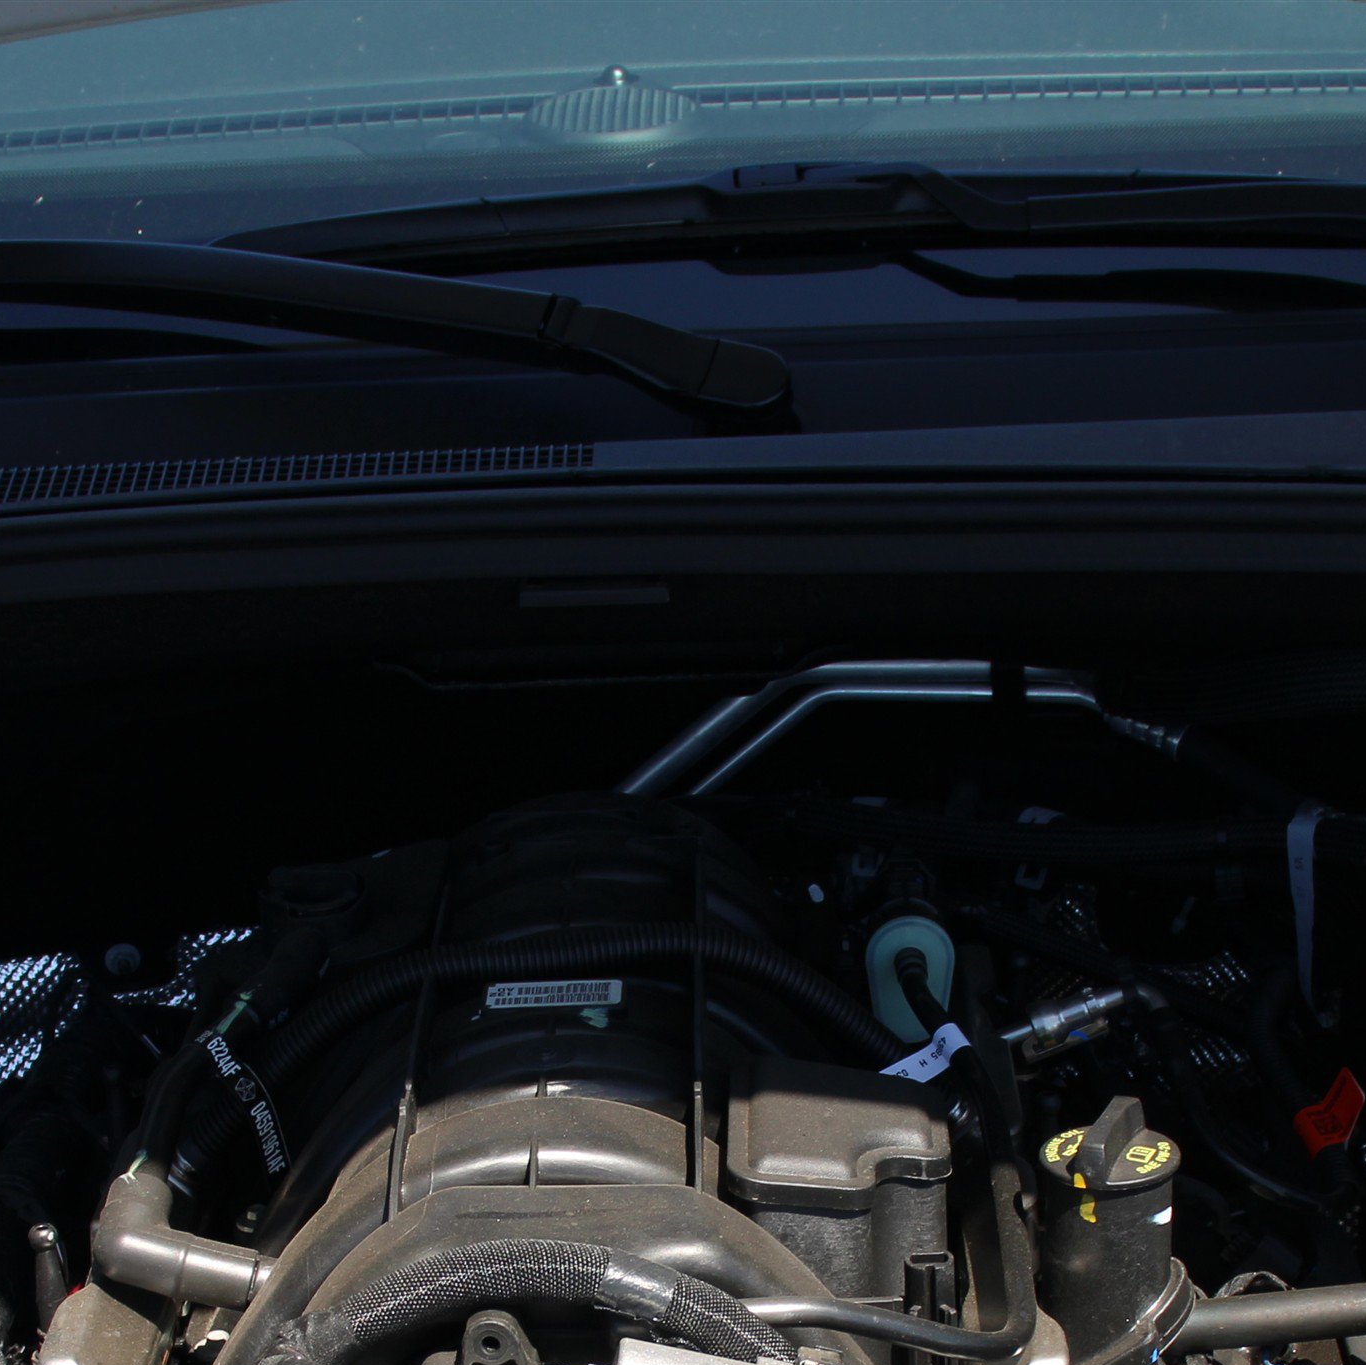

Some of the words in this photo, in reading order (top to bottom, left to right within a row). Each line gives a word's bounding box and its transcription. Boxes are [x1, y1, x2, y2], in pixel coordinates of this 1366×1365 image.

[206, 1036, 241, 1077] 62244F
[250, 1101, 285, 1174] 04591961AF
[1045, 1138, 1065, 1162] ENGINE
[1060, 1129, 1084, 1138] OIL
[1136, 1160, 1161, 1174] SAE
